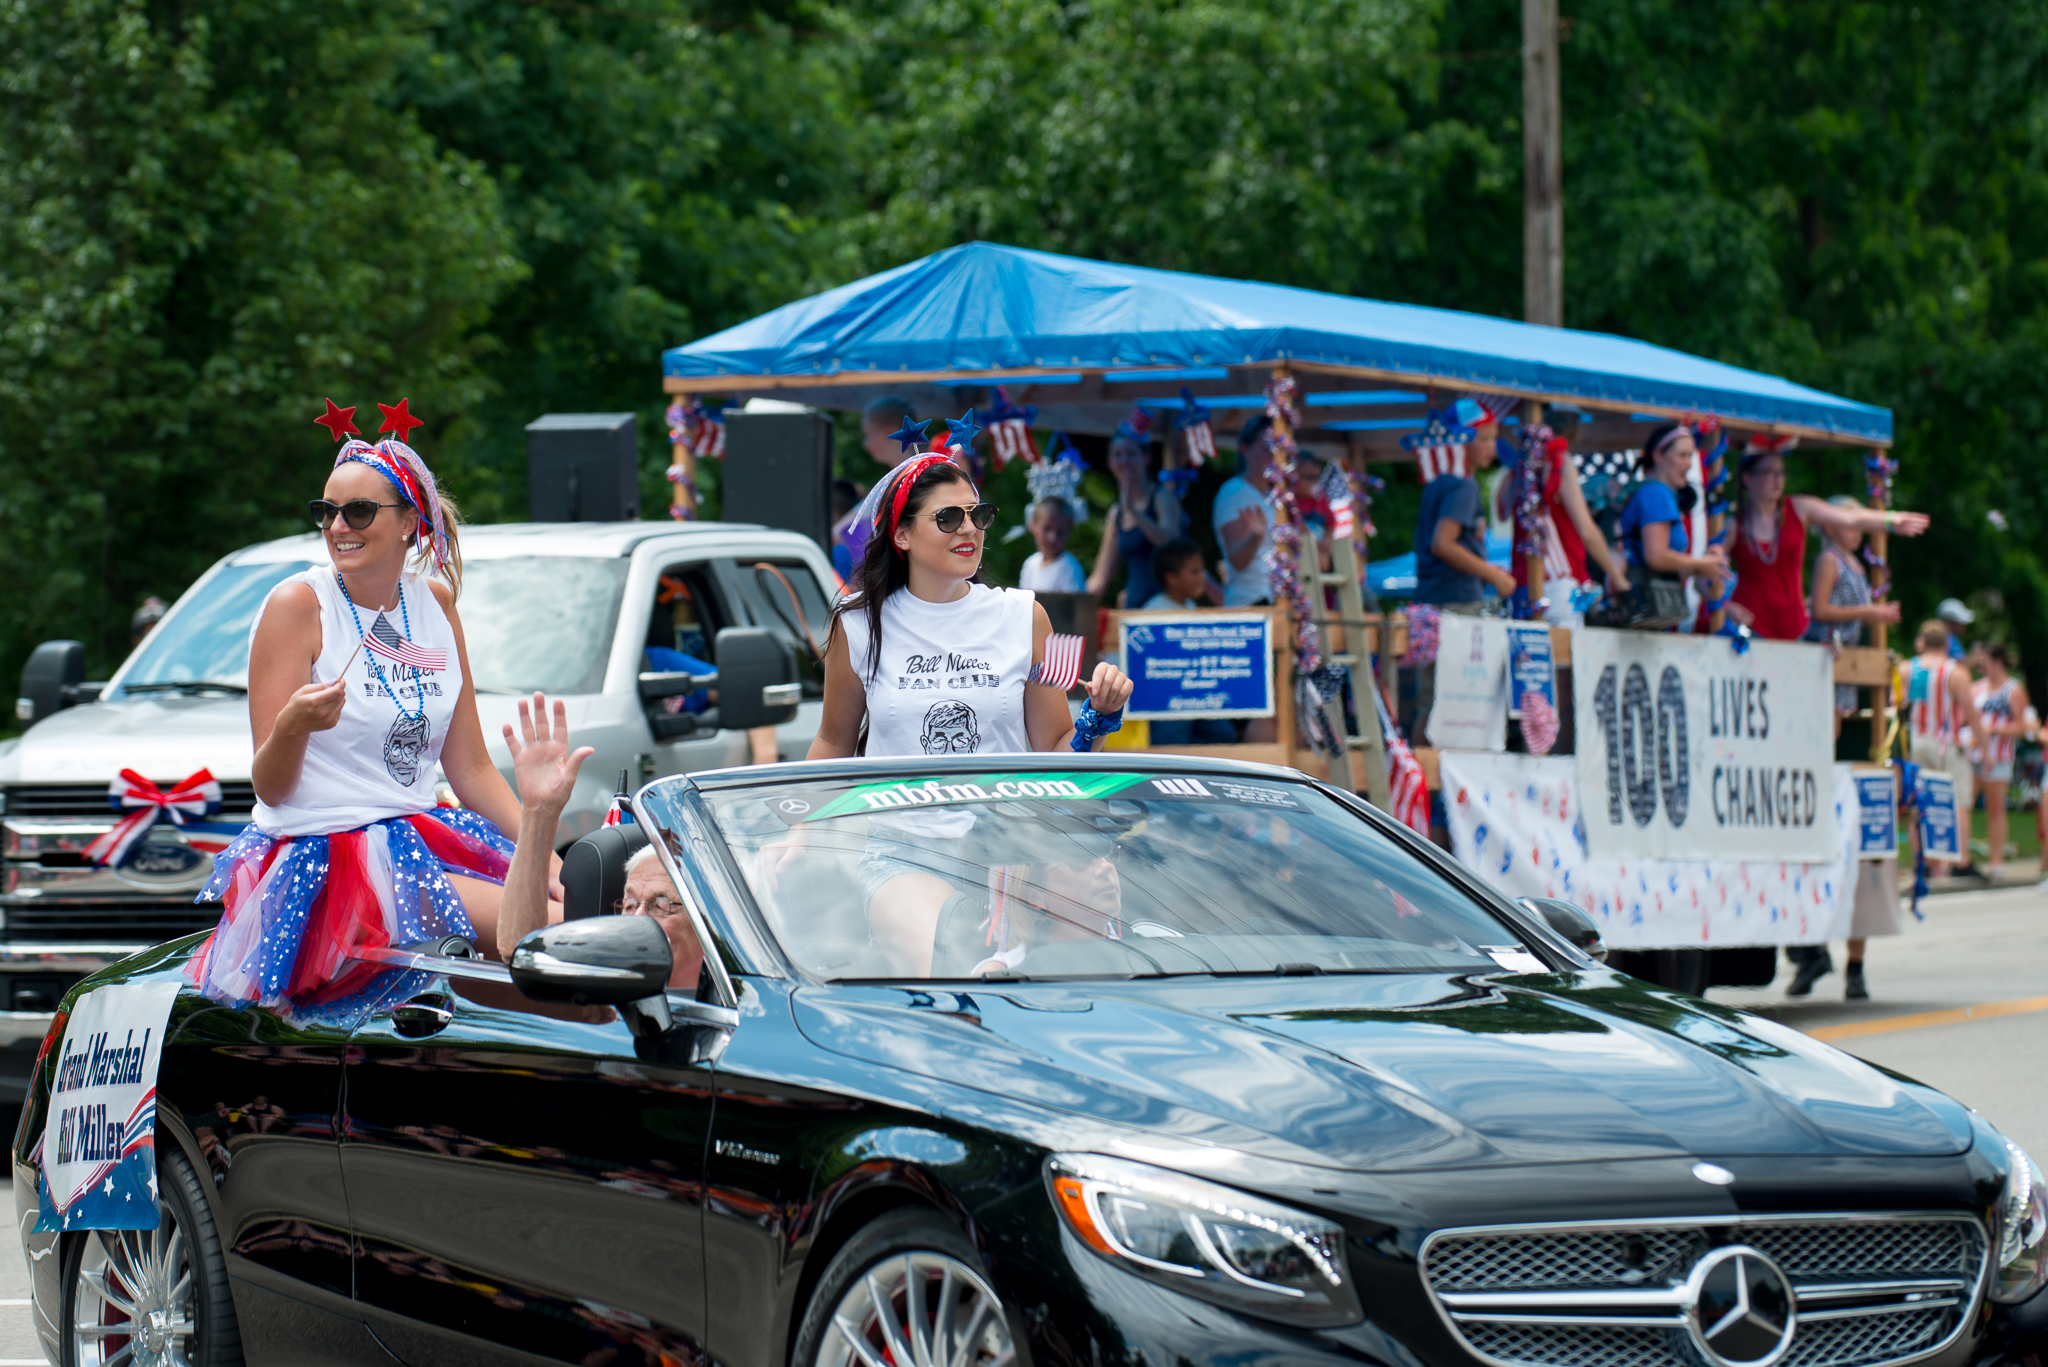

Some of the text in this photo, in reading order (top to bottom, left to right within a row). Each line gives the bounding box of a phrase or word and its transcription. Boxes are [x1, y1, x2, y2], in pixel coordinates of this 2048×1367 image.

[899, 673, 1000, 690] FAN CLUB
[906, 652, 992, 674] Bill Miller
[1709, 675, 1770, 740] LIVES
[1594, 661, 1690, 828] 100
[859, 779, 1088, 809] mbfm.com
[1711, 764, 1817, 829] CHANGED
[57, 1027, 151, 1094] Grand Marshal
[57, 1103, 125, 1166] Bill Miller
